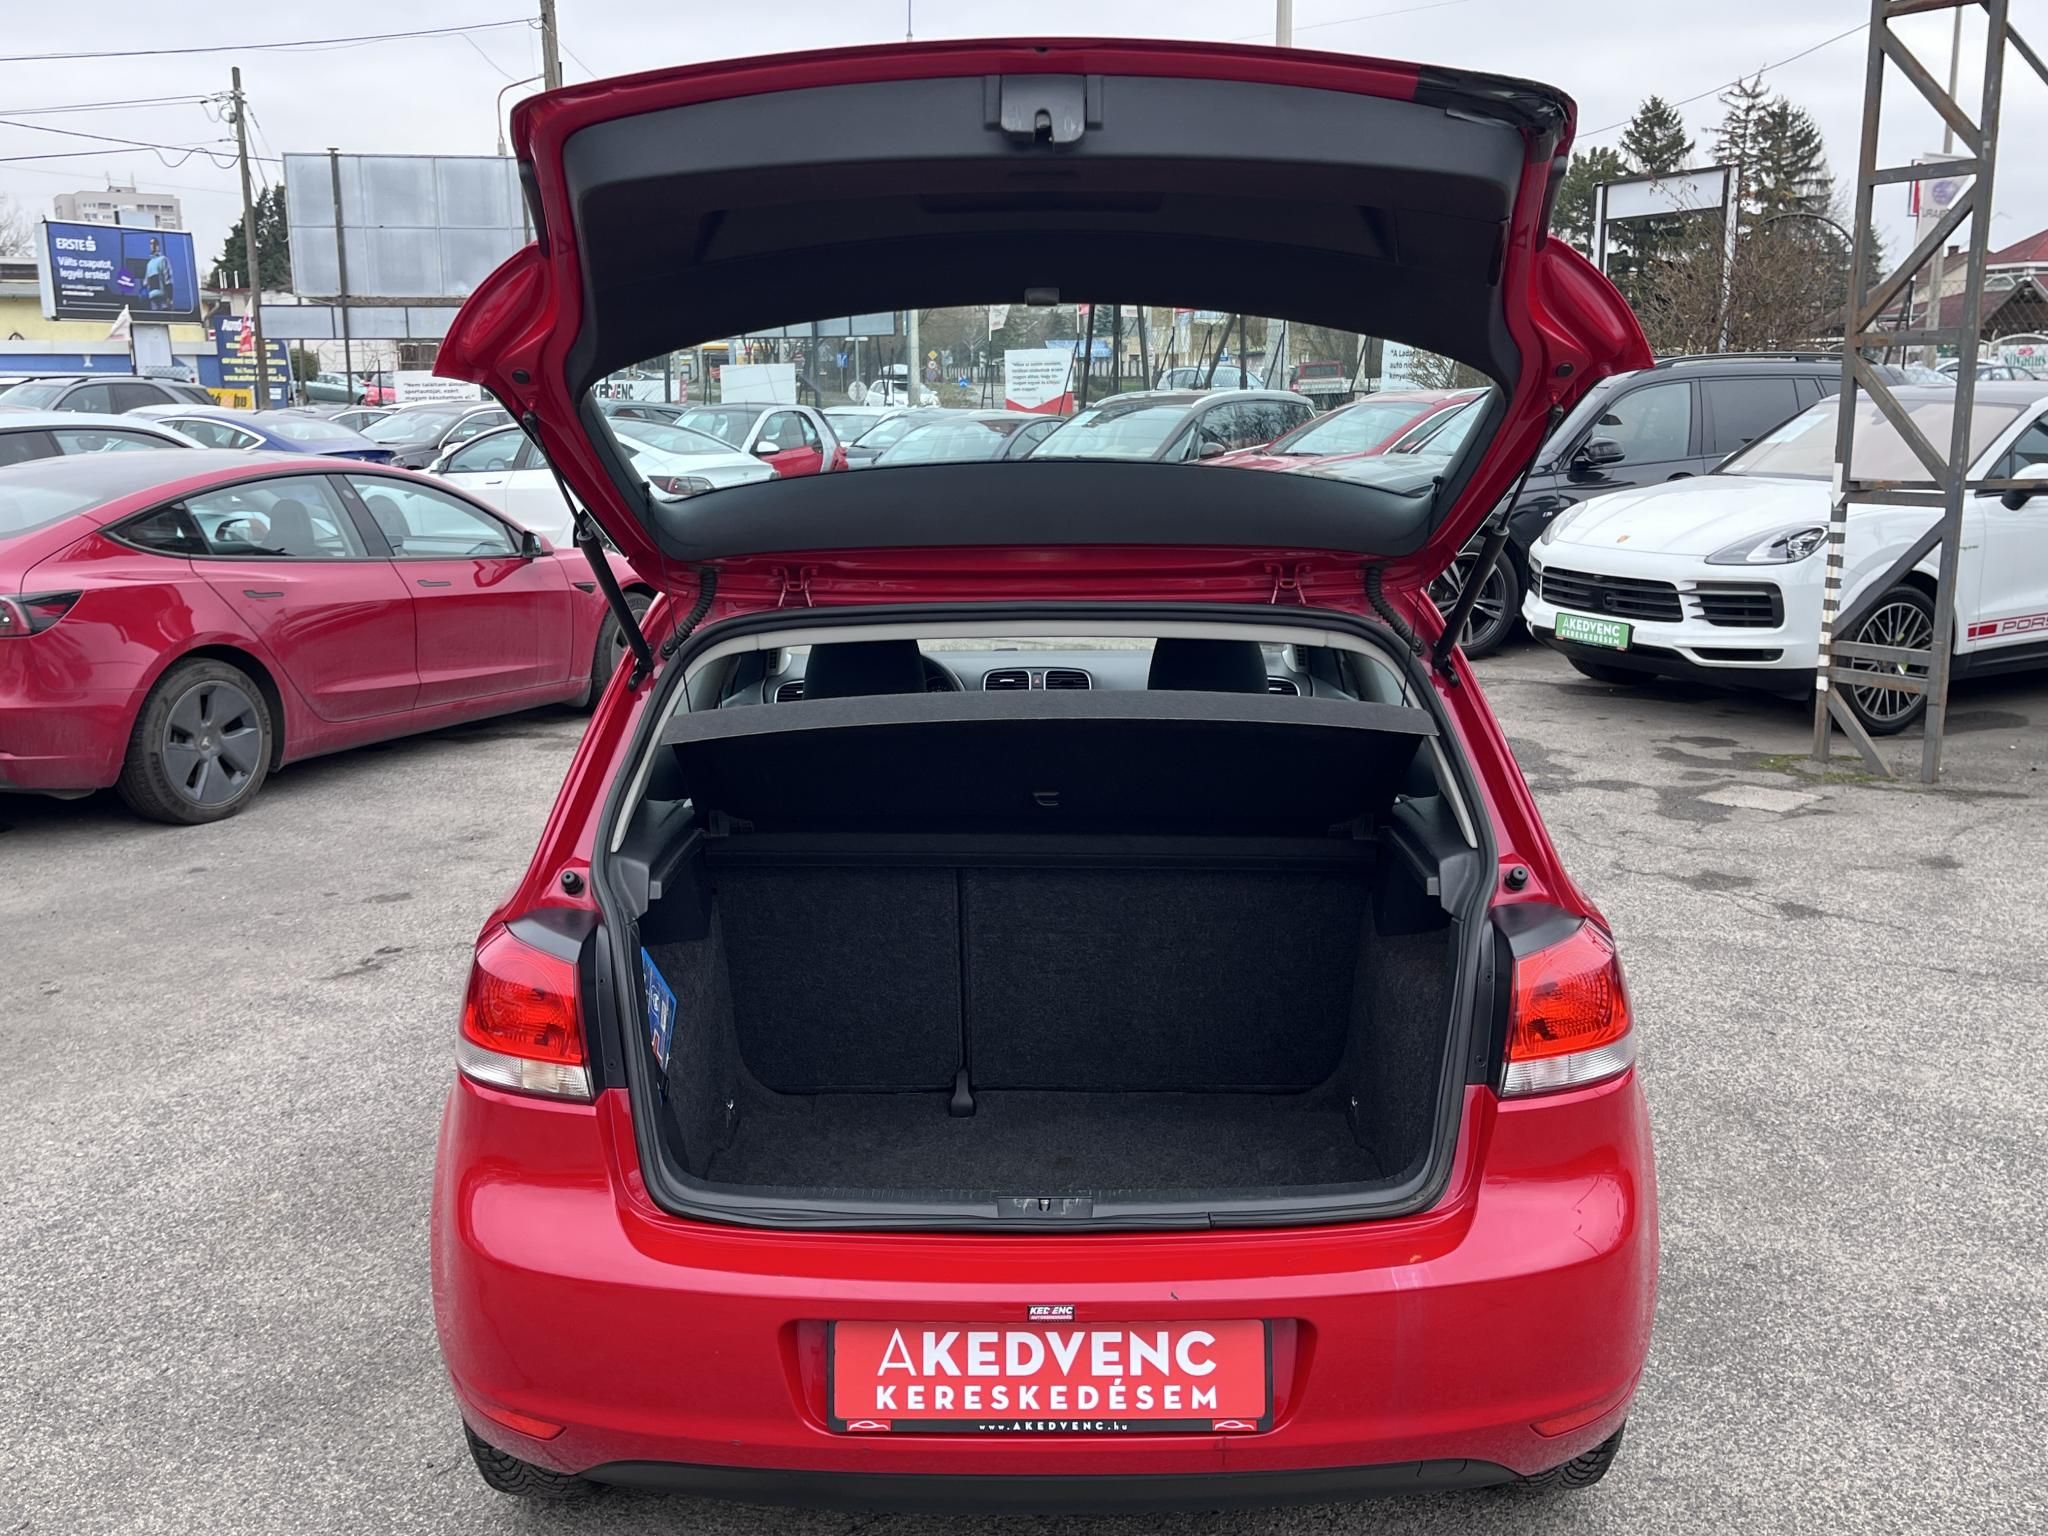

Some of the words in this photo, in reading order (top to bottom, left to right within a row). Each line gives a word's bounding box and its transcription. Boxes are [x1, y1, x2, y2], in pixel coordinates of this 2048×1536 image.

[55, 238, 86, 251] ERSTE
[1562, 616, 1620, 637] AKEDVENC
[2001, 616, 2048, 633] POR
[877, 1327, 1217, 1377] AKEDVENC
[876, 1378, 1217, 1411] KERESKEDÉSEM
[978, 1420, 1128, 1431] www.AKEDVENC.hu
